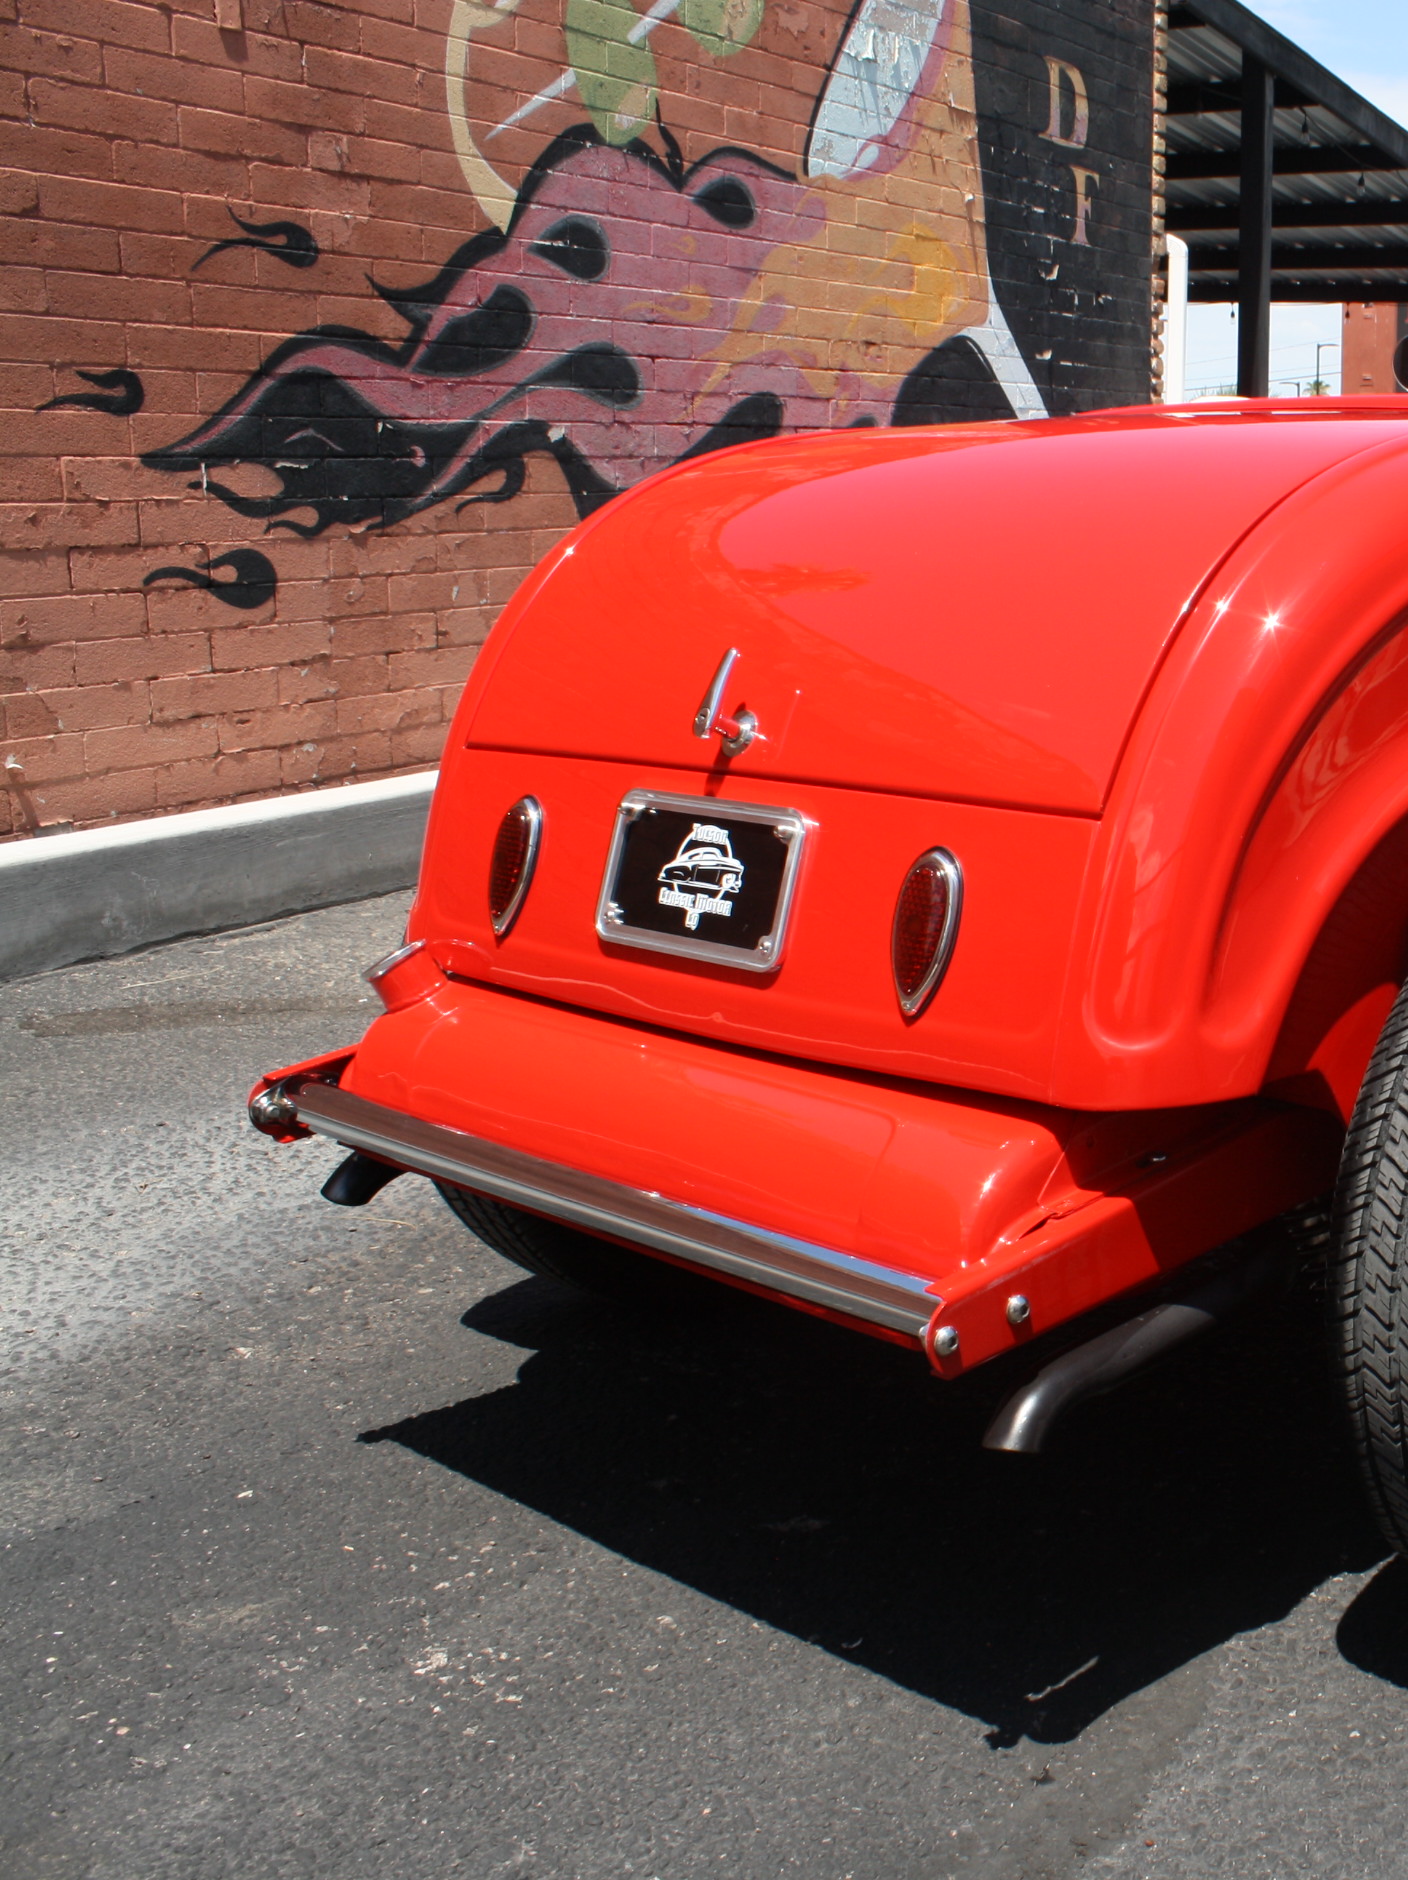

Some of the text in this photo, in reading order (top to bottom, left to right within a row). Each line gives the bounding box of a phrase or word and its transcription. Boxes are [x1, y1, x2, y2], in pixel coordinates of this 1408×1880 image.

[1038, 55, 1089, 150] D
[1069, 165, 1100, 246] F
[695, 893, 733, 916] MOTOR
